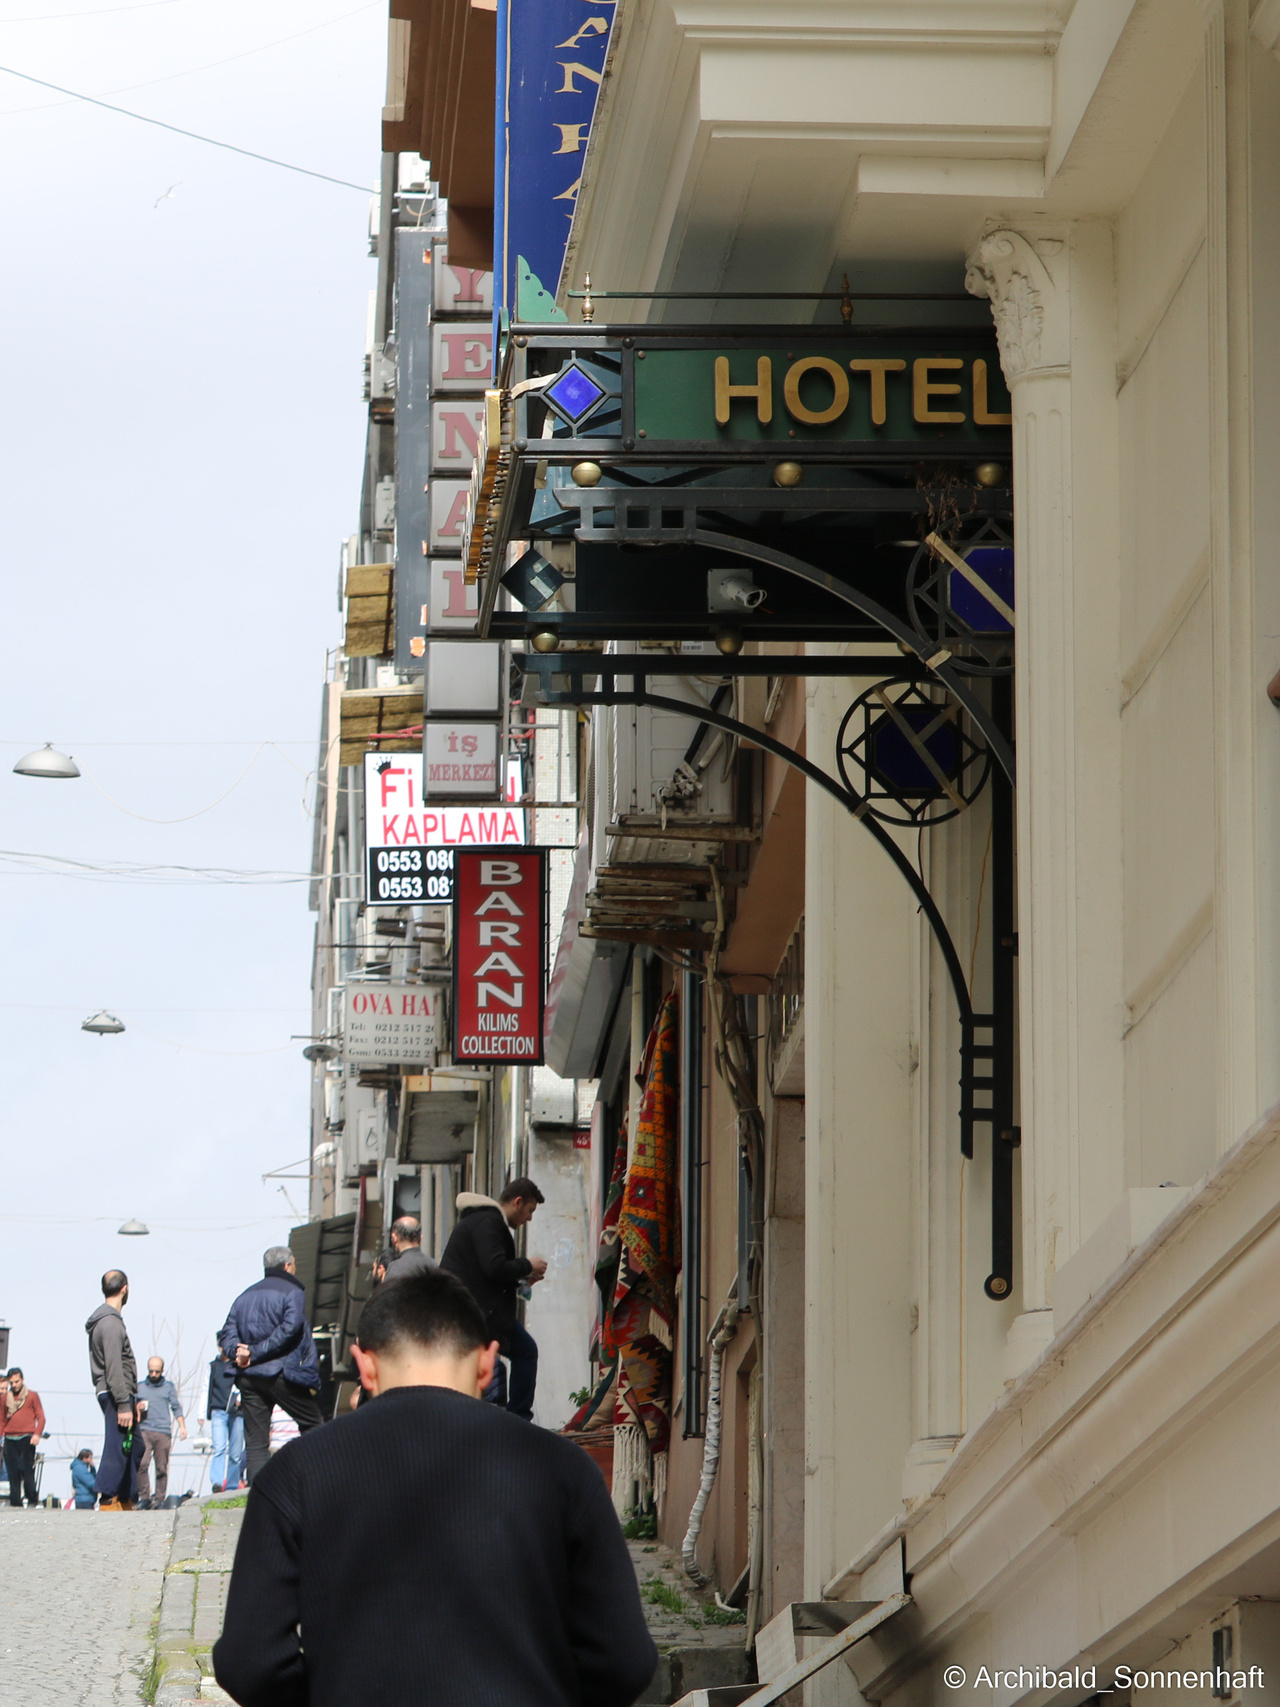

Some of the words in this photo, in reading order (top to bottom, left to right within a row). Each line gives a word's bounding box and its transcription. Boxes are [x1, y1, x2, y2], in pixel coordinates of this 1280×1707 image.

[714, 355, 1012, 426] HOTEL
[447, 731, 479, 758] İŞ
[428, 760, 496, 782] MERKEZİ
[382, 812, 520, 845] KAPLAMA
[377, 850, 422, 873] 0553
[378, 876, 423, 899] 0553
[473, 860, 525, 1008] BARAN
[352, 992, 394, 1015] OVA
[350, 1023, 366, 1031] Tel:
[375, 1023, 400, 1032] 0212
[478, 1013, 519, 1032] KILIMS
[461, 1036, 535, 1055] COLLECTION
